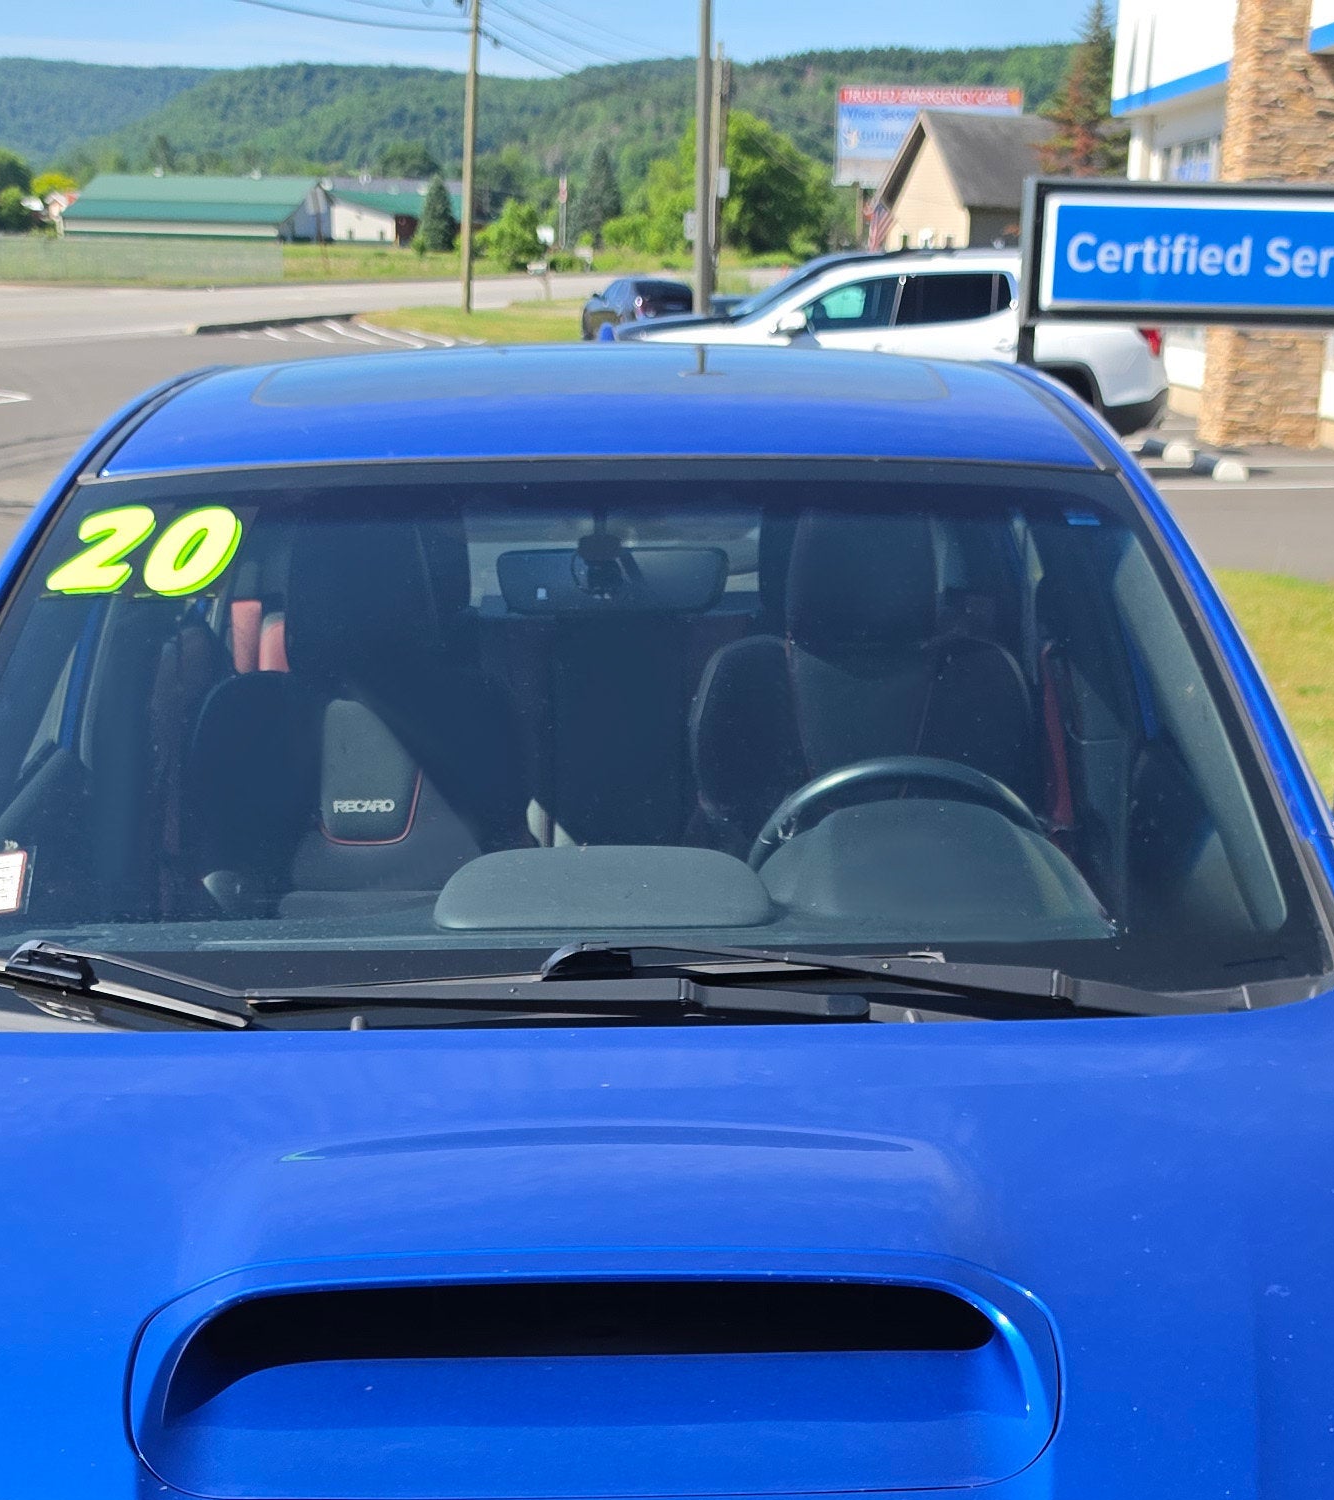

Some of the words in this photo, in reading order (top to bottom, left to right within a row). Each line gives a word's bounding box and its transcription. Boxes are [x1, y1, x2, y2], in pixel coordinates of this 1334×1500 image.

[1067, 232, 1253, 276] Certified
[46, 504, 243, 597] 20
[333, 799, 396, 814] RECARO
